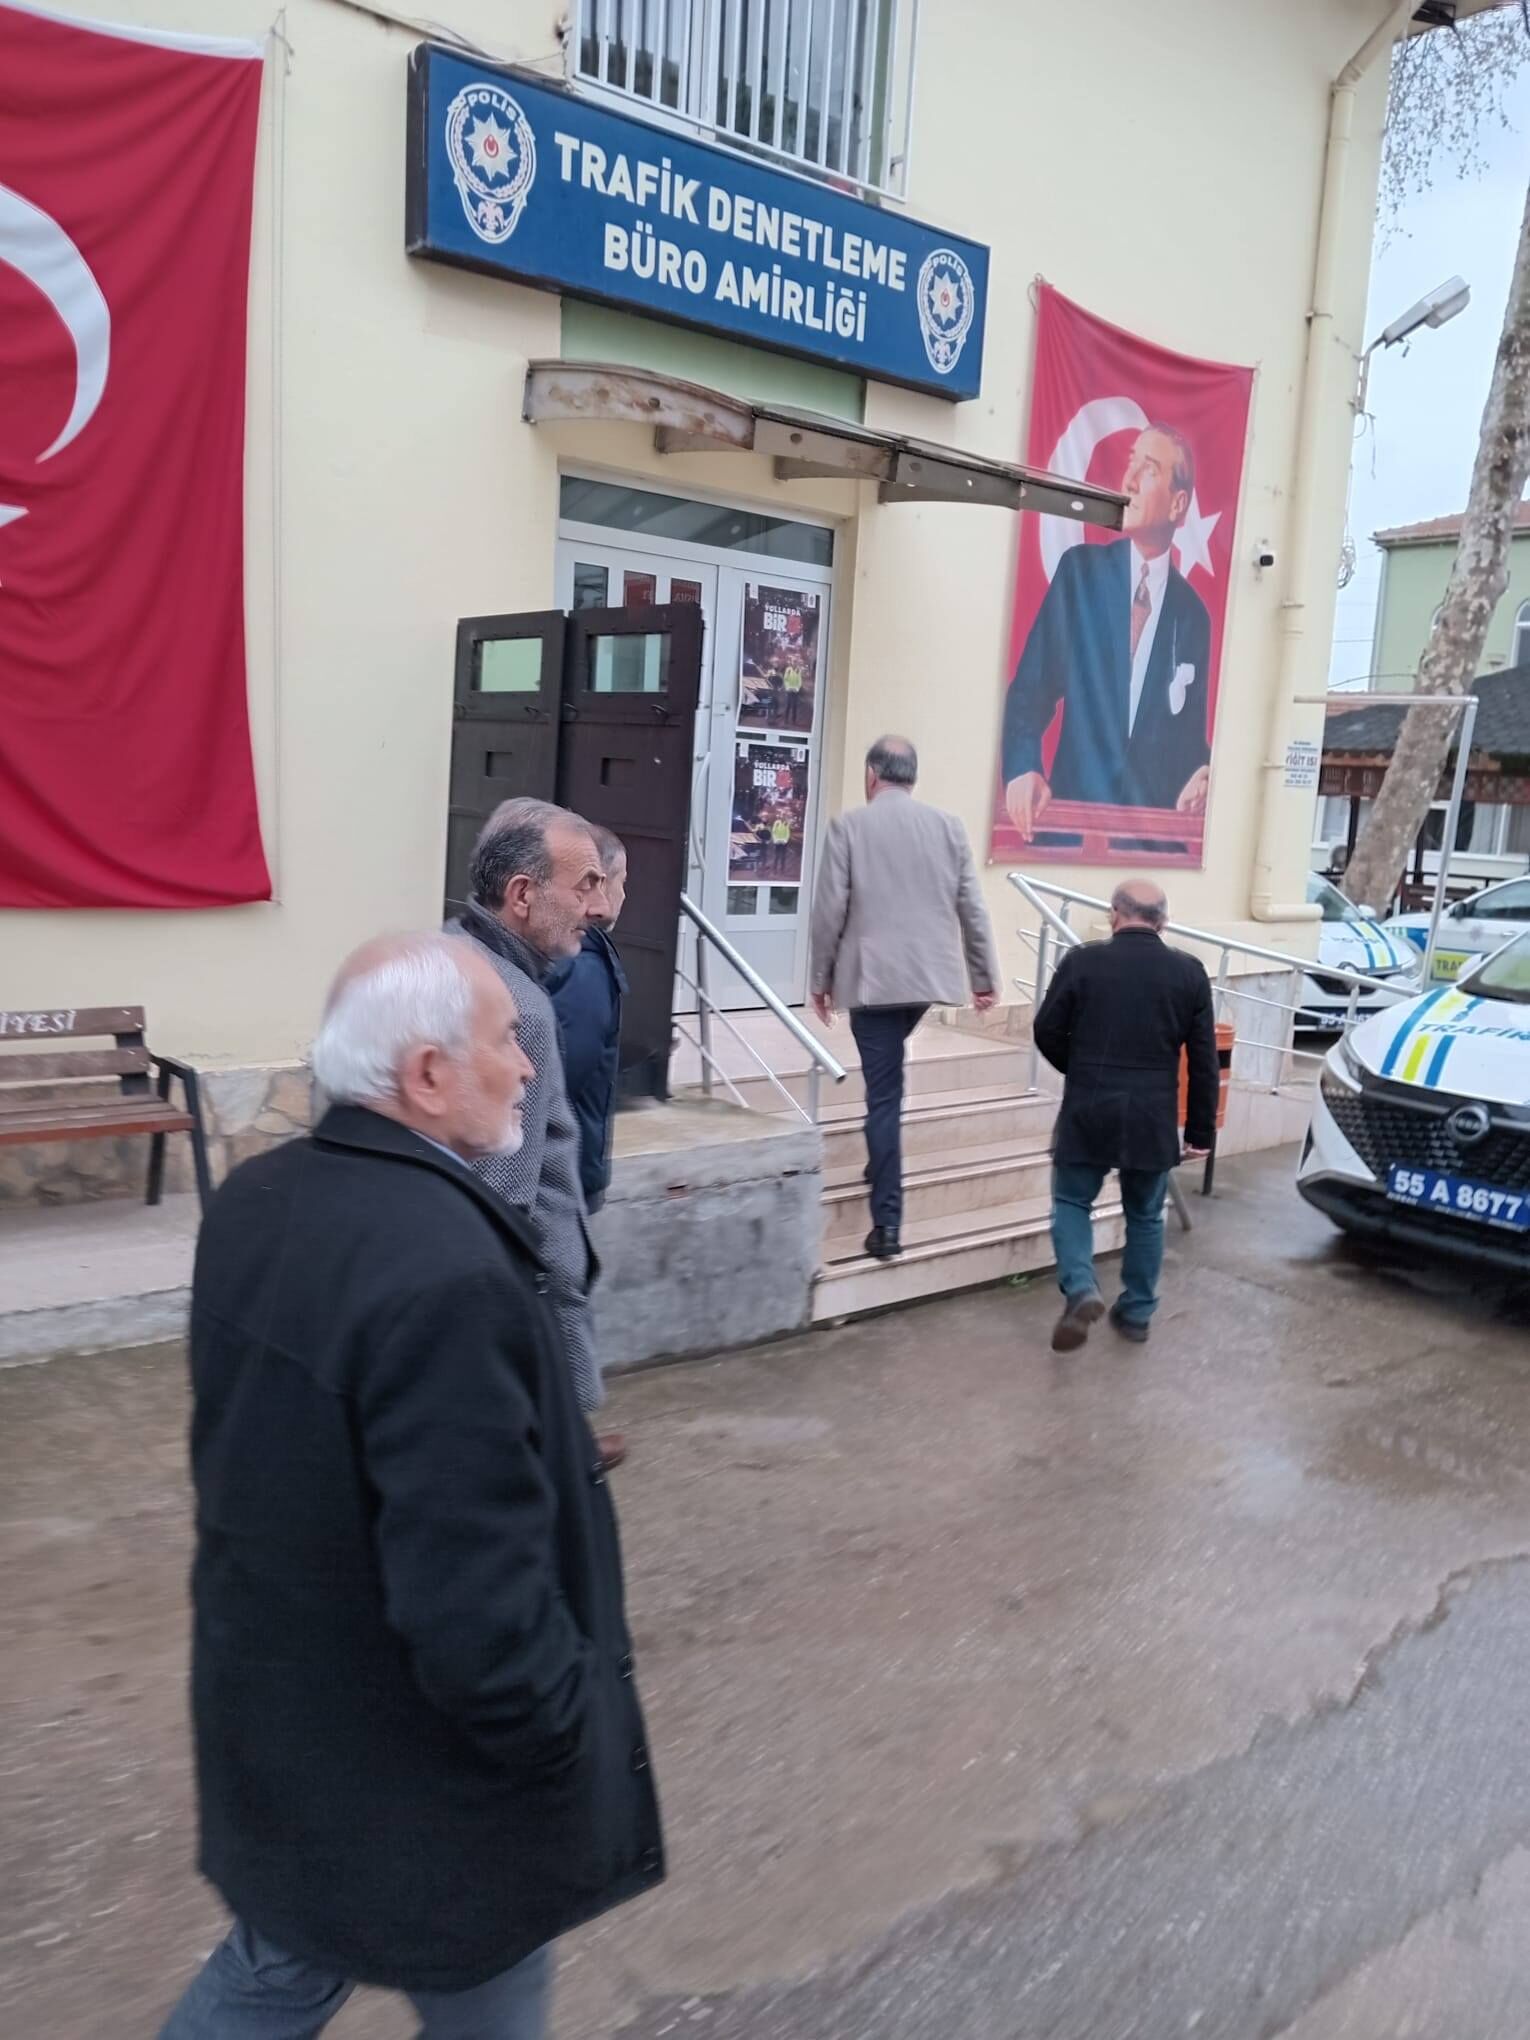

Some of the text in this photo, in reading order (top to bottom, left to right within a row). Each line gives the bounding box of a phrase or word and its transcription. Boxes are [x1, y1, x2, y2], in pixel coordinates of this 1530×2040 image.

[554, 130, 907, 292] TRAFİK DENETLEME
[604, 219, 867, 342] BÜRO AMİRLİĞİ
[1394, 1169, 1425, 1197] 55
[1429, 1178, 1450, 1204] A
[1456, 1183, 1523, 1221] 8677
